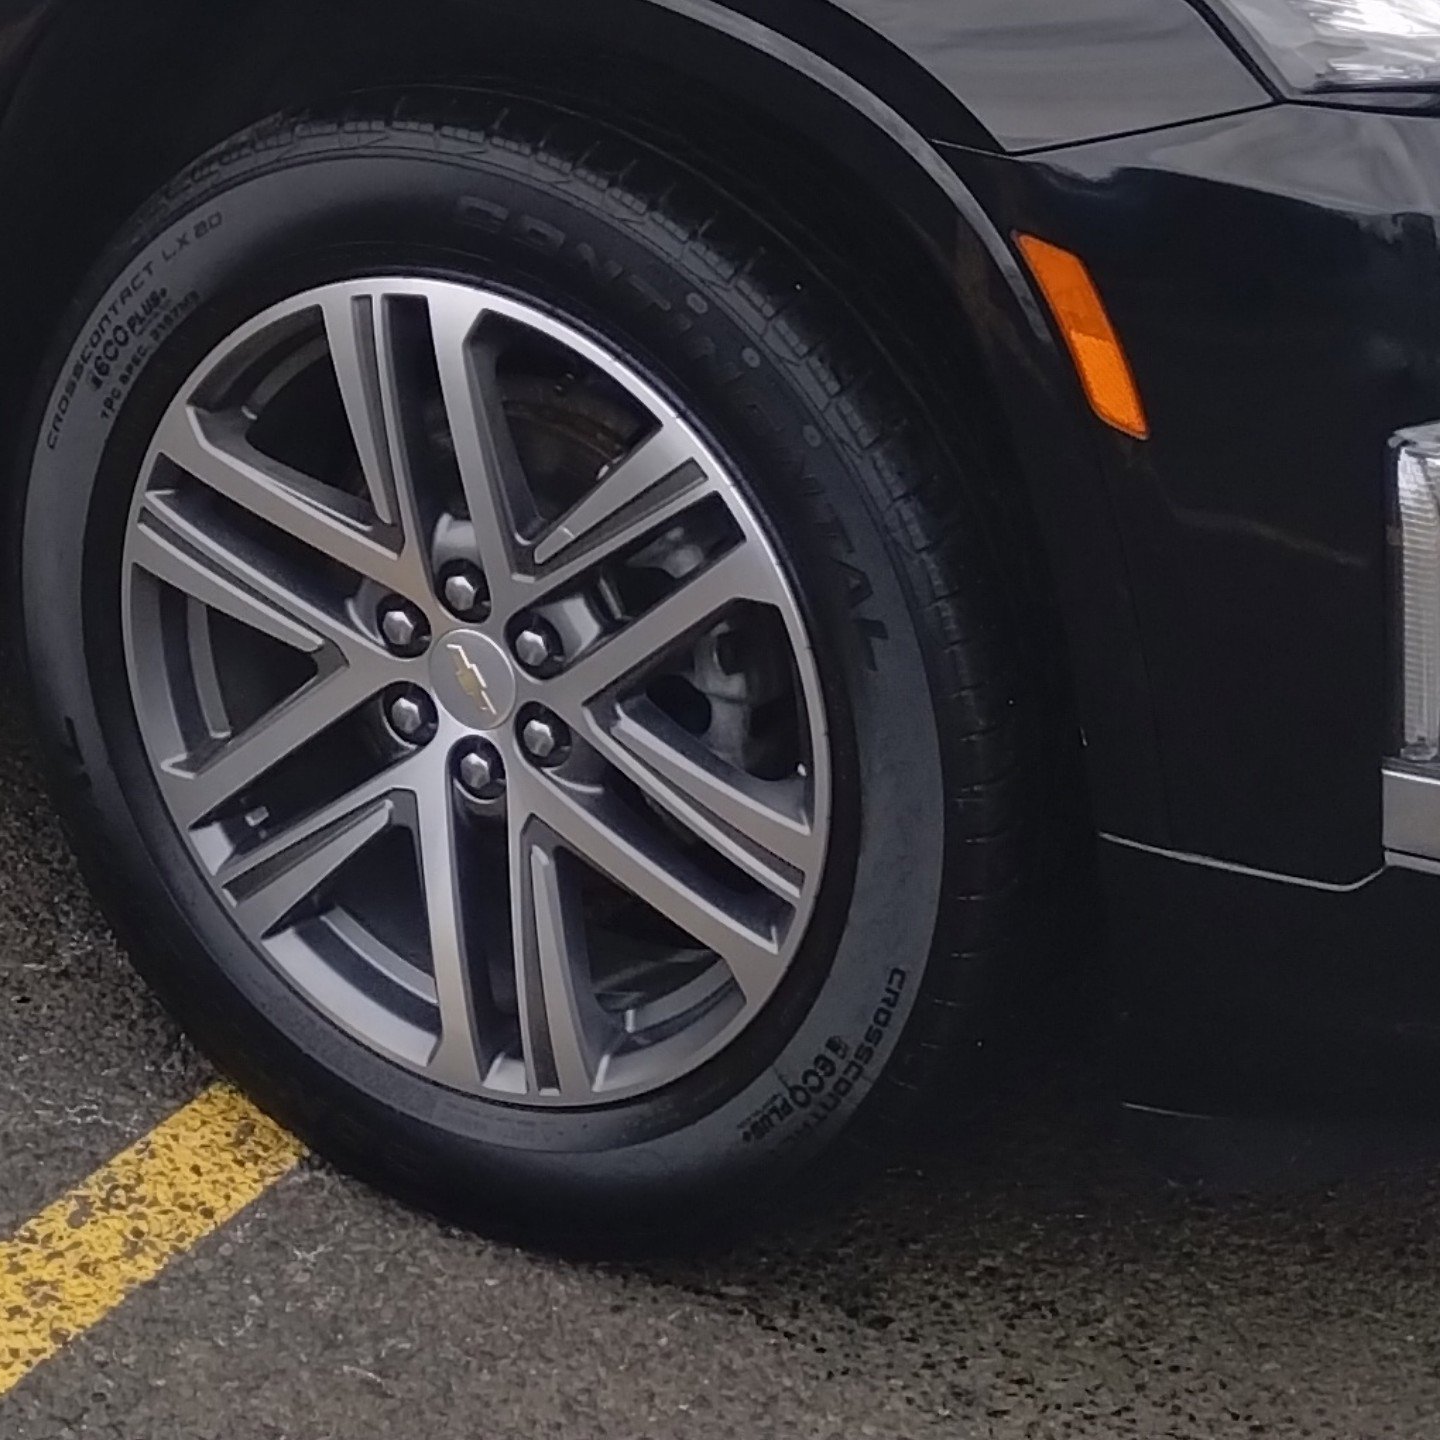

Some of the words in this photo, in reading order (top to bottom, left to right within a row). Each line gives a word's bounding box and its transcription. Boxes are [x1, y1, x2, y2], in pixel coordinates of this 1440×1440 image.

[46, 259, 155, 451] CROSSCONTACT
[162, 232, 190, 262] LX
[195, 211, 222, 239] 20
